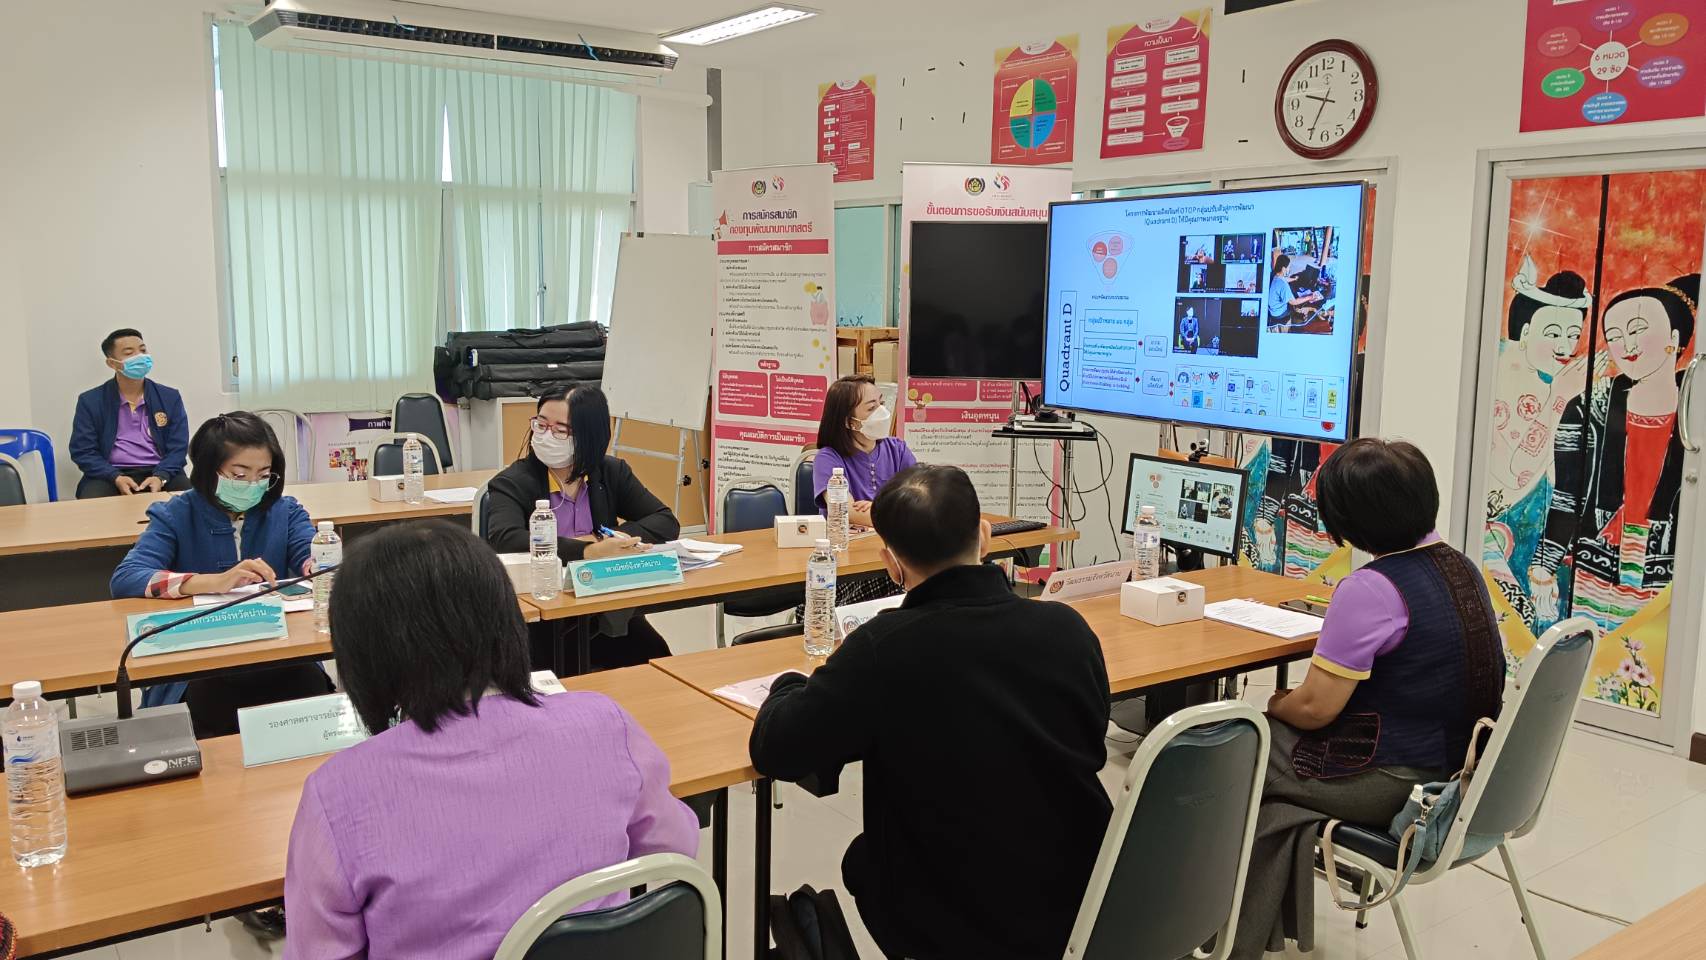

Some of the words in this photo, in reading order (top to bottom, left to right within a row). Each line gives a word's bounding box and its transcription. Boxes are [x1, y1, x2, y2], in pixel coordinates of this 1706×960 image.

[1322, 57, 1335, 71] 12
[1594, 53, 1601, 62] 6
[1309, 64, 1318, 78] 11
[1341, 60, 1346, 73] 1
[1596, 66, 1608, 76] 29
[1350, 71, 1360, 85] 2
[1297, 79, 1309, 93] 10
[1353, 88, 1364, 102] 3
[1290, 97, 1300, 111] 9
[1294, 114, 1304, 128] 8
[1346, 108, 1356, 121] 4
[1307, 127, 1316, 141] 7
[1320, 130, 1330, 143] 6
[1334, 123, 1345, 137] 5
[742, 208, 798, 220] การสมัครสมาชิก
[926, 202, 1048, 220] ขั้นตอนการขอรับเงินสนับสนุน
[729, 221, 813, 237] กองทุนพัฒนาบทบาทสตรี
[1062, 303, 1072, 315] D
[1059, 320, 1072, 392] Quadrant
[960, 410, 1000, 423] เงินอุดหนุน
[168, 755, 196, 766] NPE
